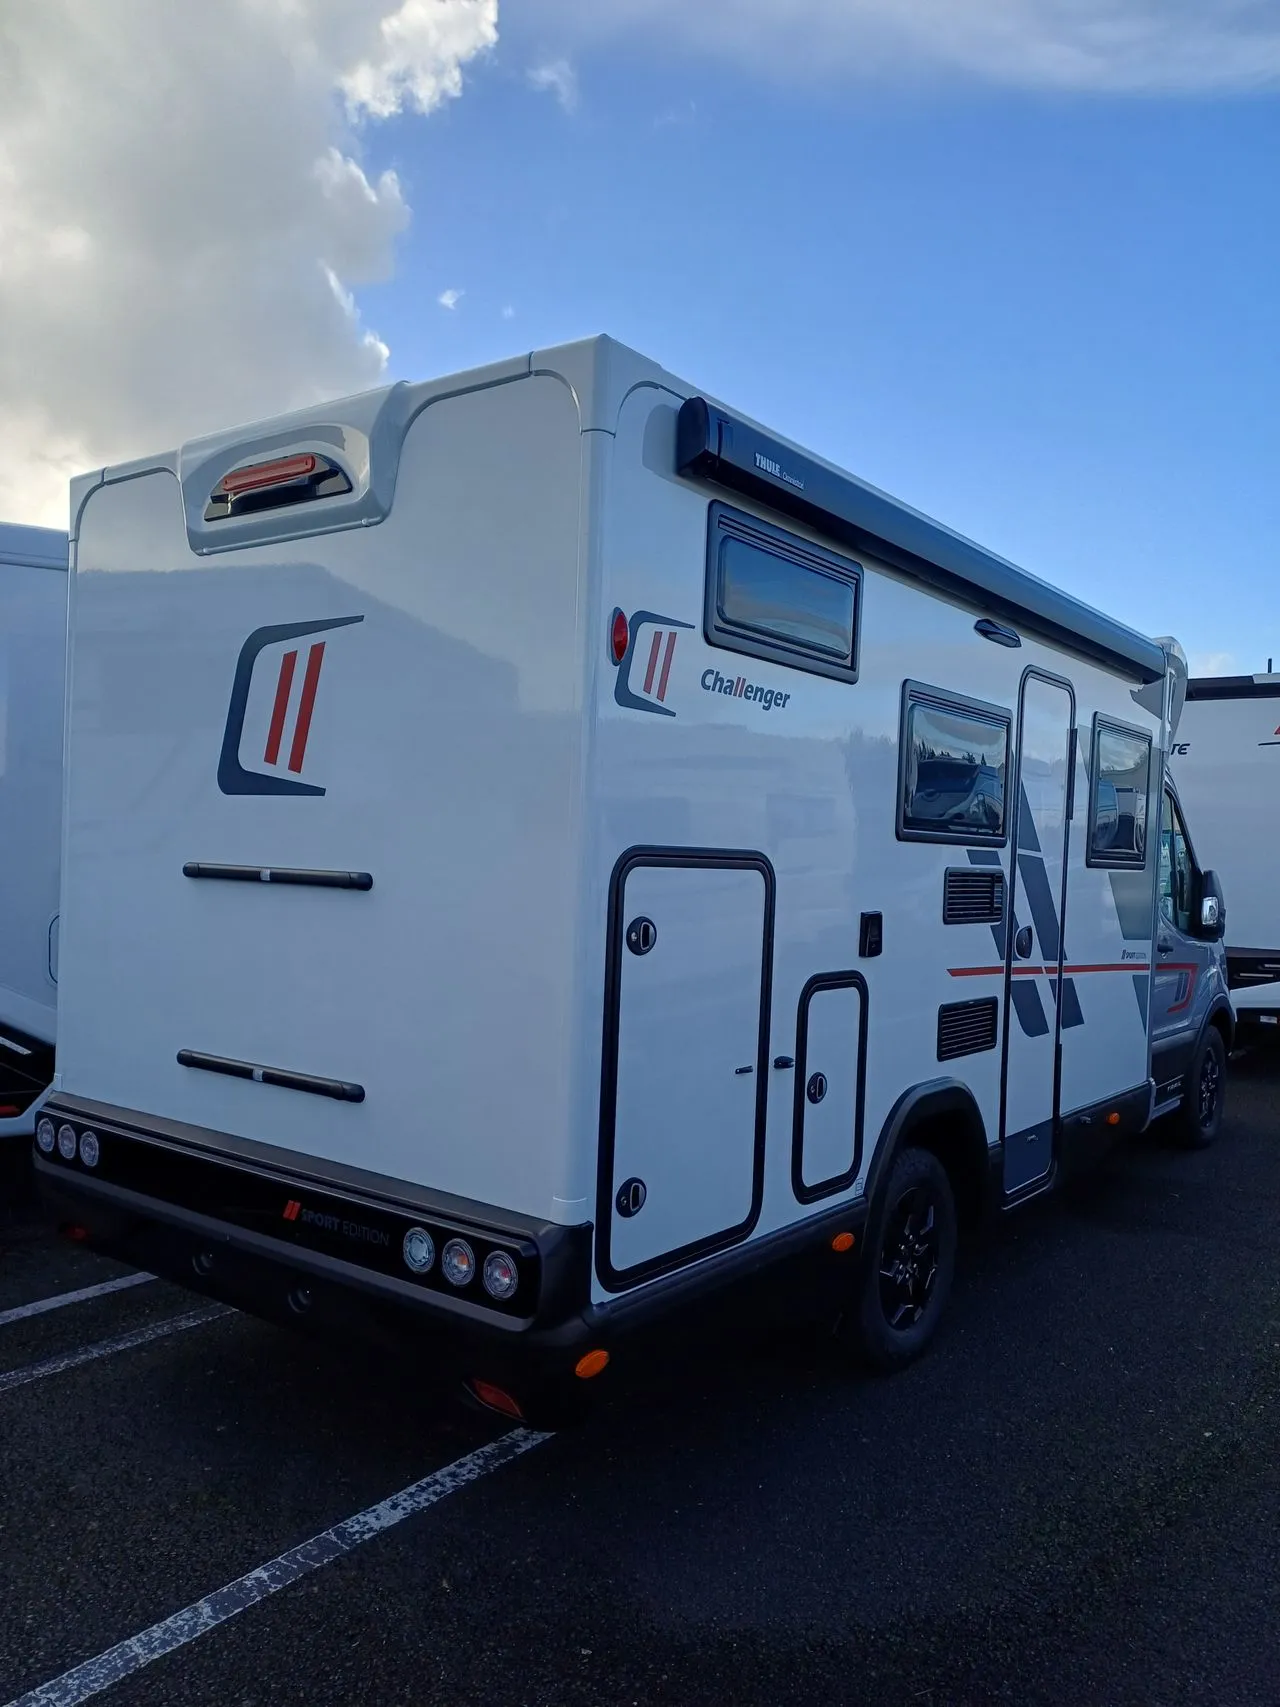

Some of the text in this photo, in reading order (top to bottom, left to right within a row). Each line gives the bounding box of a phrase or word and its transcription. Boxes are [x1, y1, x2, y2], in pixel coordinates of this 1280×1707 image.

[755, 452, 781, 477] THULE
[700, 668, 791, 711] Challenger
[300, 1208, 391, 1247] SPORT EDITION
